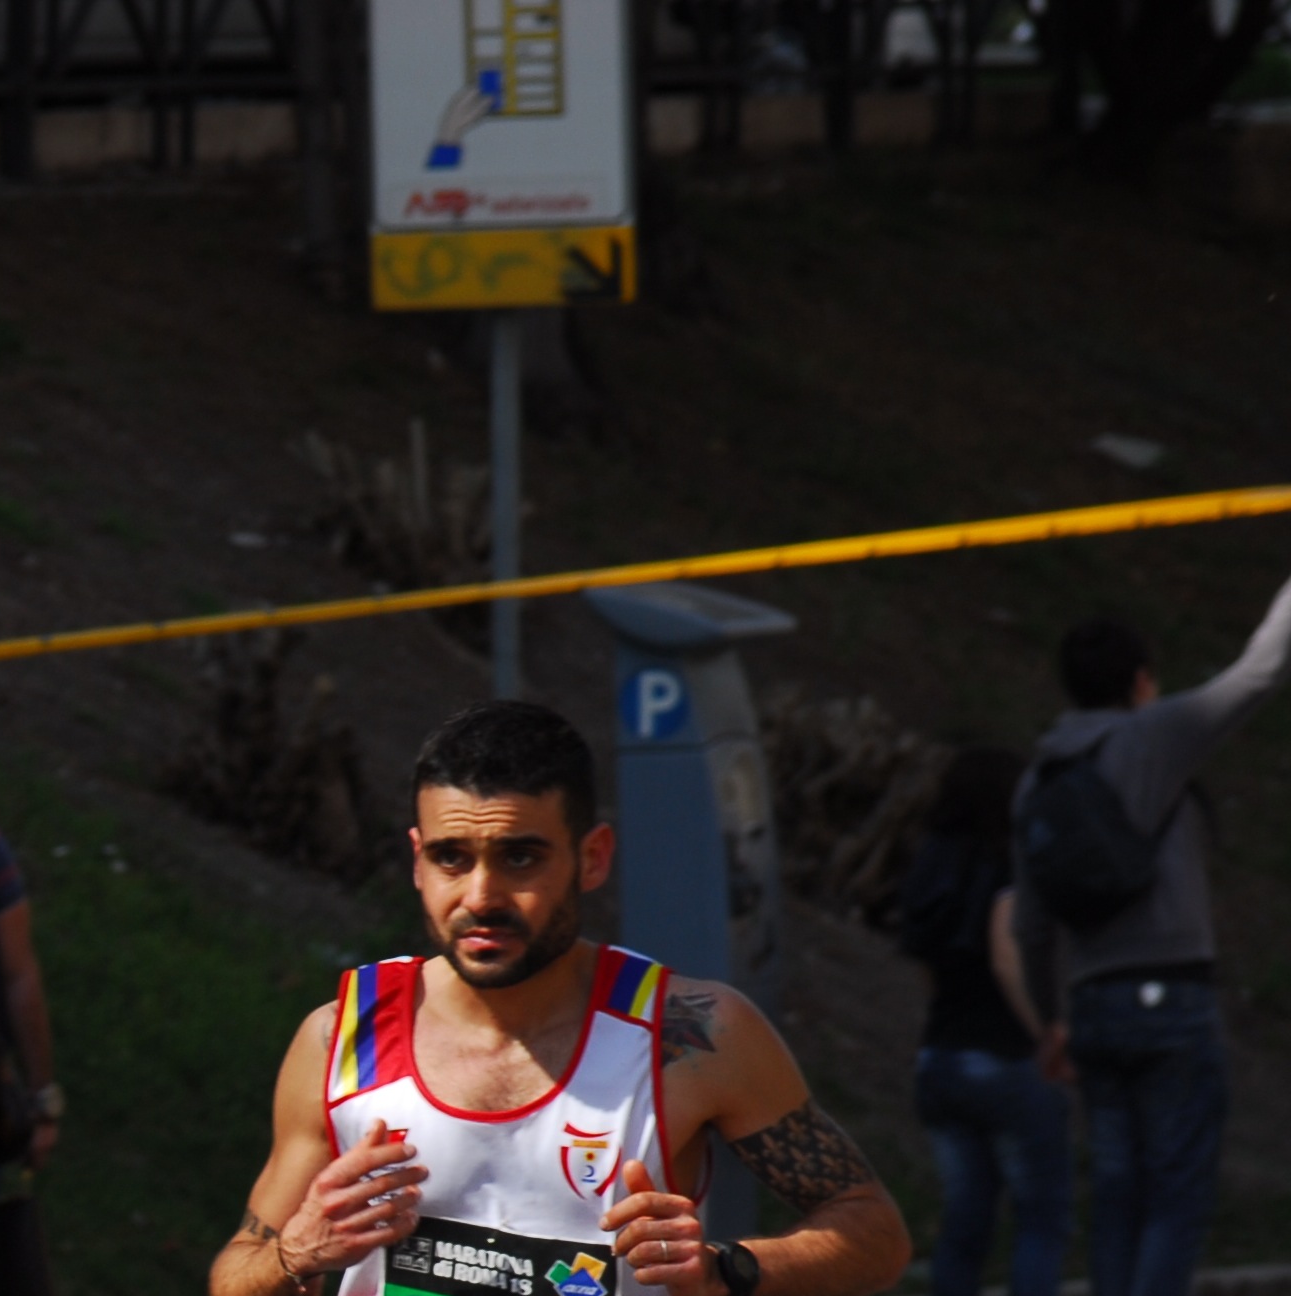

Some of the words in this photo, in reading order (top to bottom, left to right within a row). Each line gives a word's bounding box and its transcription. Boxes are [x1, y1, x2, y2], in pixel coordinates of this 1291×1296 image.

[640, 669, 680, 737] P
[434, 1241, 534, 1277] MARATONA
[453, 1262, 507, 1290] ROMA
